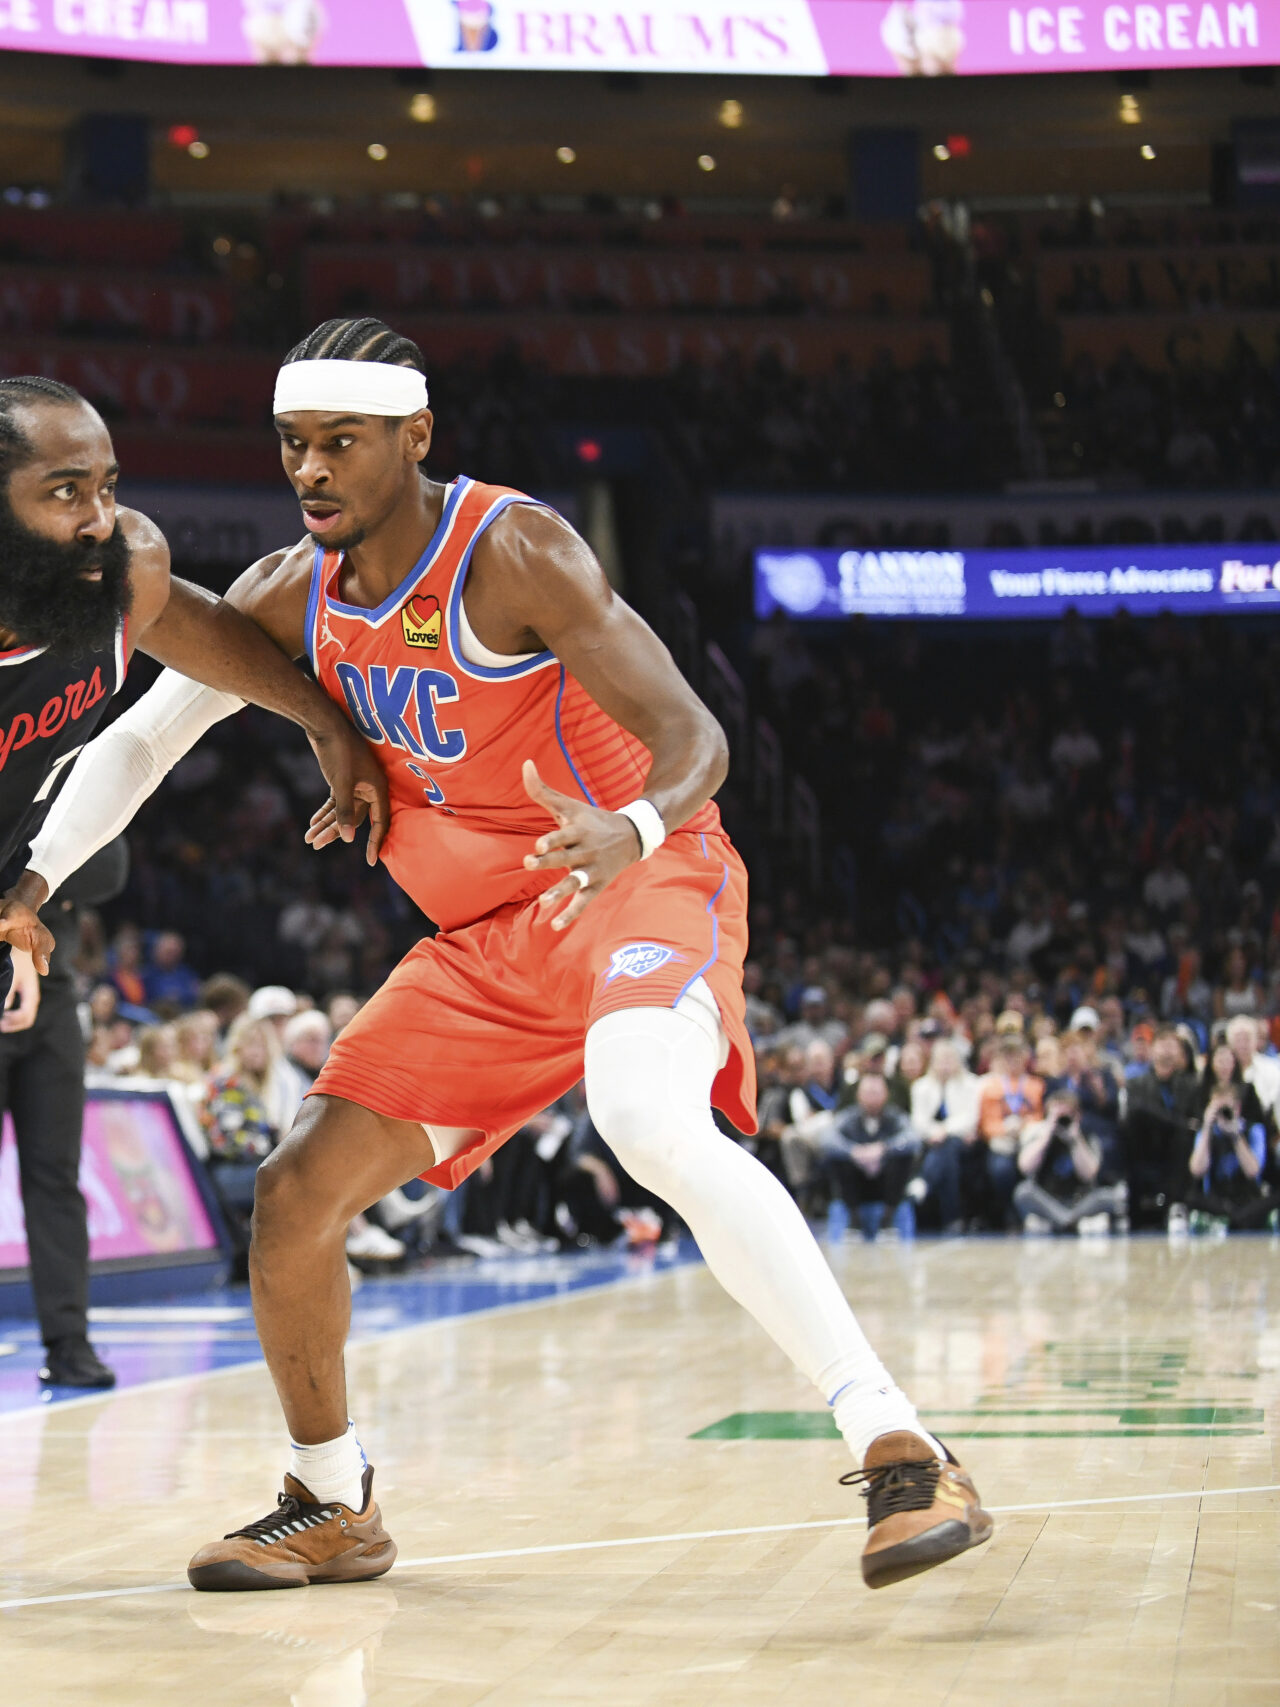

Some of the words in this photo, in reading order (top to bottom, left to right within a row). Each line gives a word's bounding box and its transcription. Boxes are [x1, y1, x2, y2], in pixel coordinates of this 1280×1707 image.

[1008, 6, 1086, 55] ICE
[1104, 2, 1259, 52] CREAM
[335, 662, 467, 763] OKC
